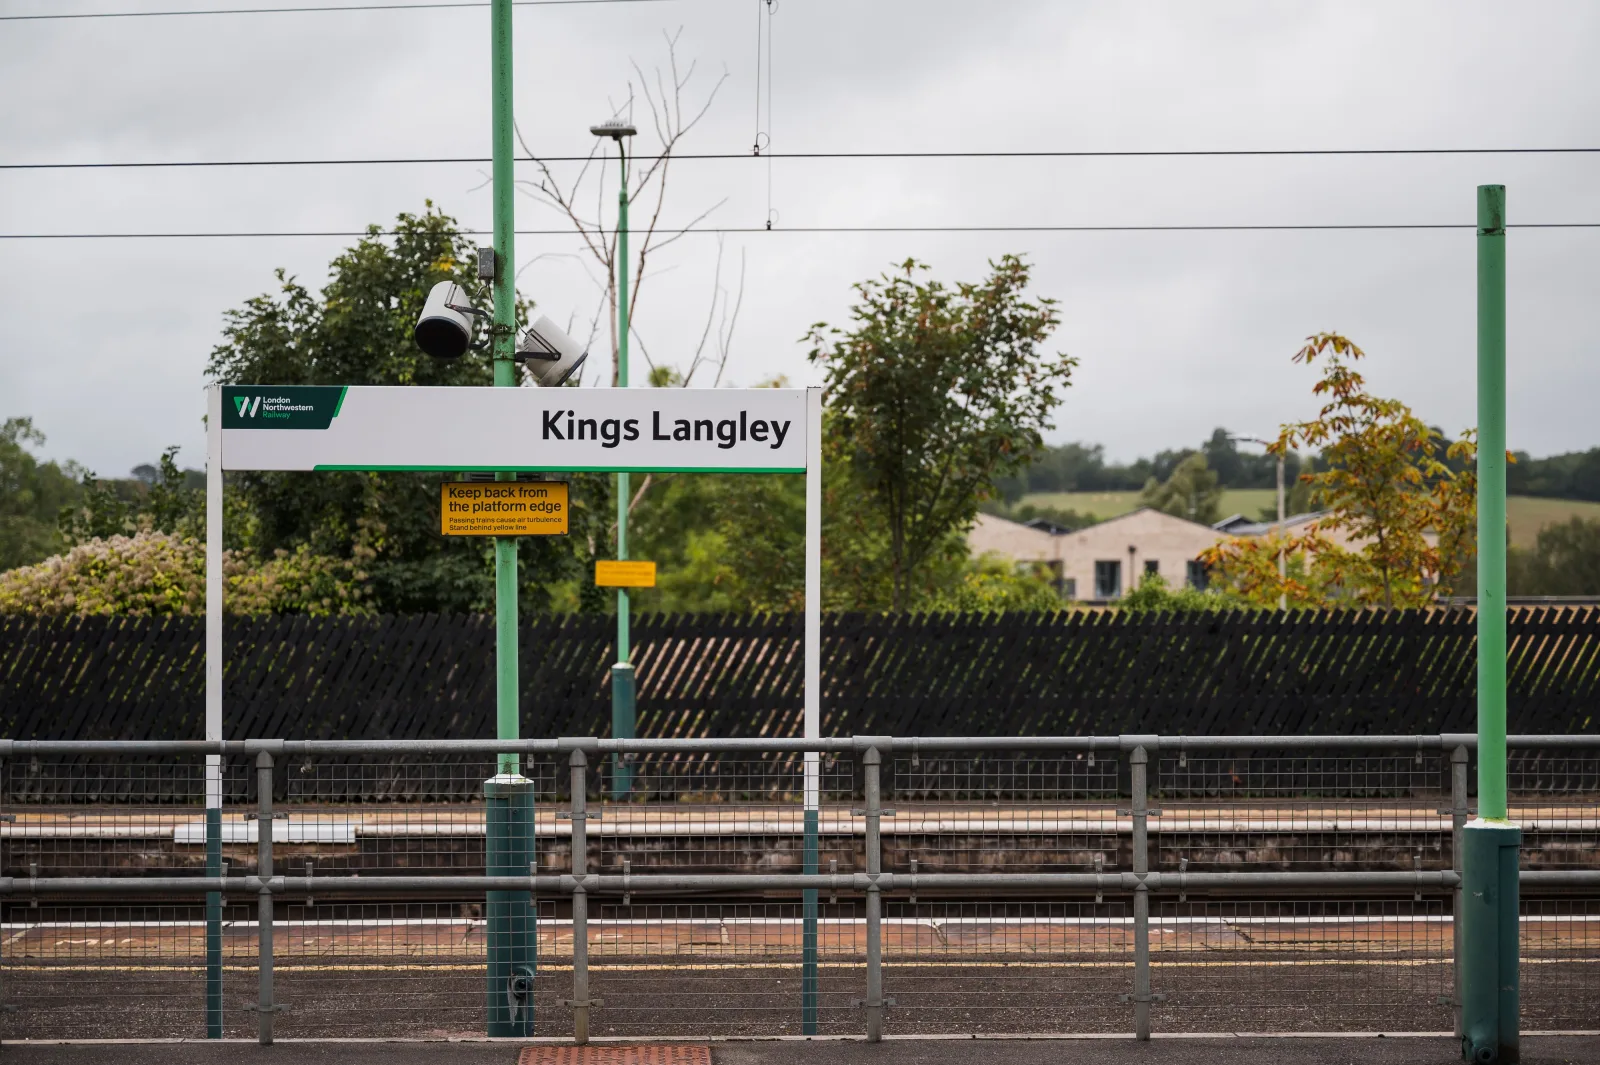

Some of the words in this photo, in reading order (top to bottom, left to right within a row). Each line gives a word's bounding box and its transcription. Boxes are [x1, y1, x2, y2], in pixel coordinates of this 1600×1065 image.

[543, 410, 639, 448] Kings
[653, 411, 791, 449] Langley
[449, 487, 481, 500] Keep
[484, 487, 515, 498] back
[518, 486, 548, 498] from
[449, 501, 470, 512] the
[472, 501, 526, 514] platform
[530, 501, 562, 513] edge
